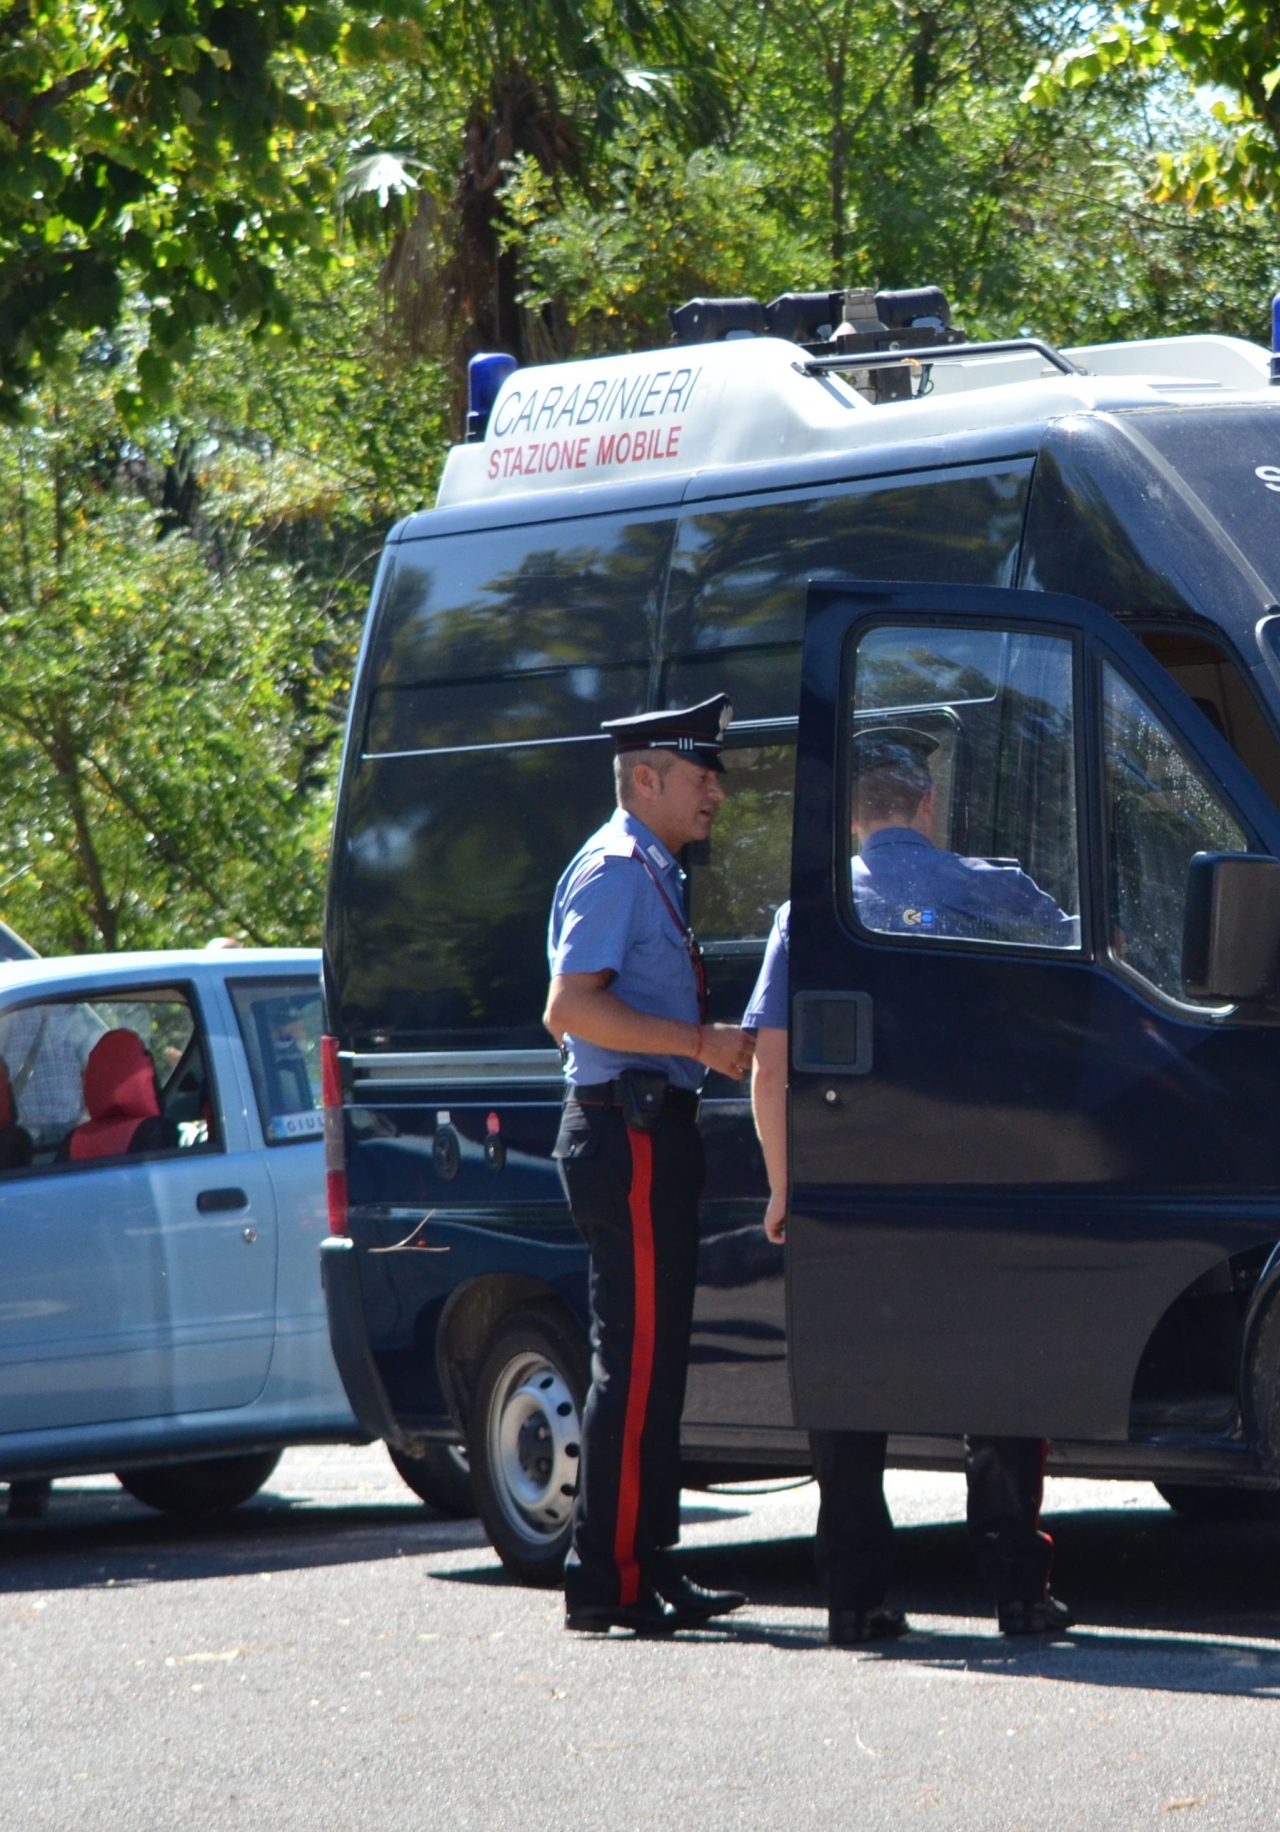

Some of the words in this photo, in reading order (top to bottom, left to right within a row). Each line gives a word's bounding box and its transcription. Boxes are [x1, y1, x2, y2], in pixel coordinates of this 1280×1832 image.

[493, 366, 702, 437] CARABINIERI
[488, 437, 590, 480] STAZIONE
[596, 426, 682, 467] MOBILE
